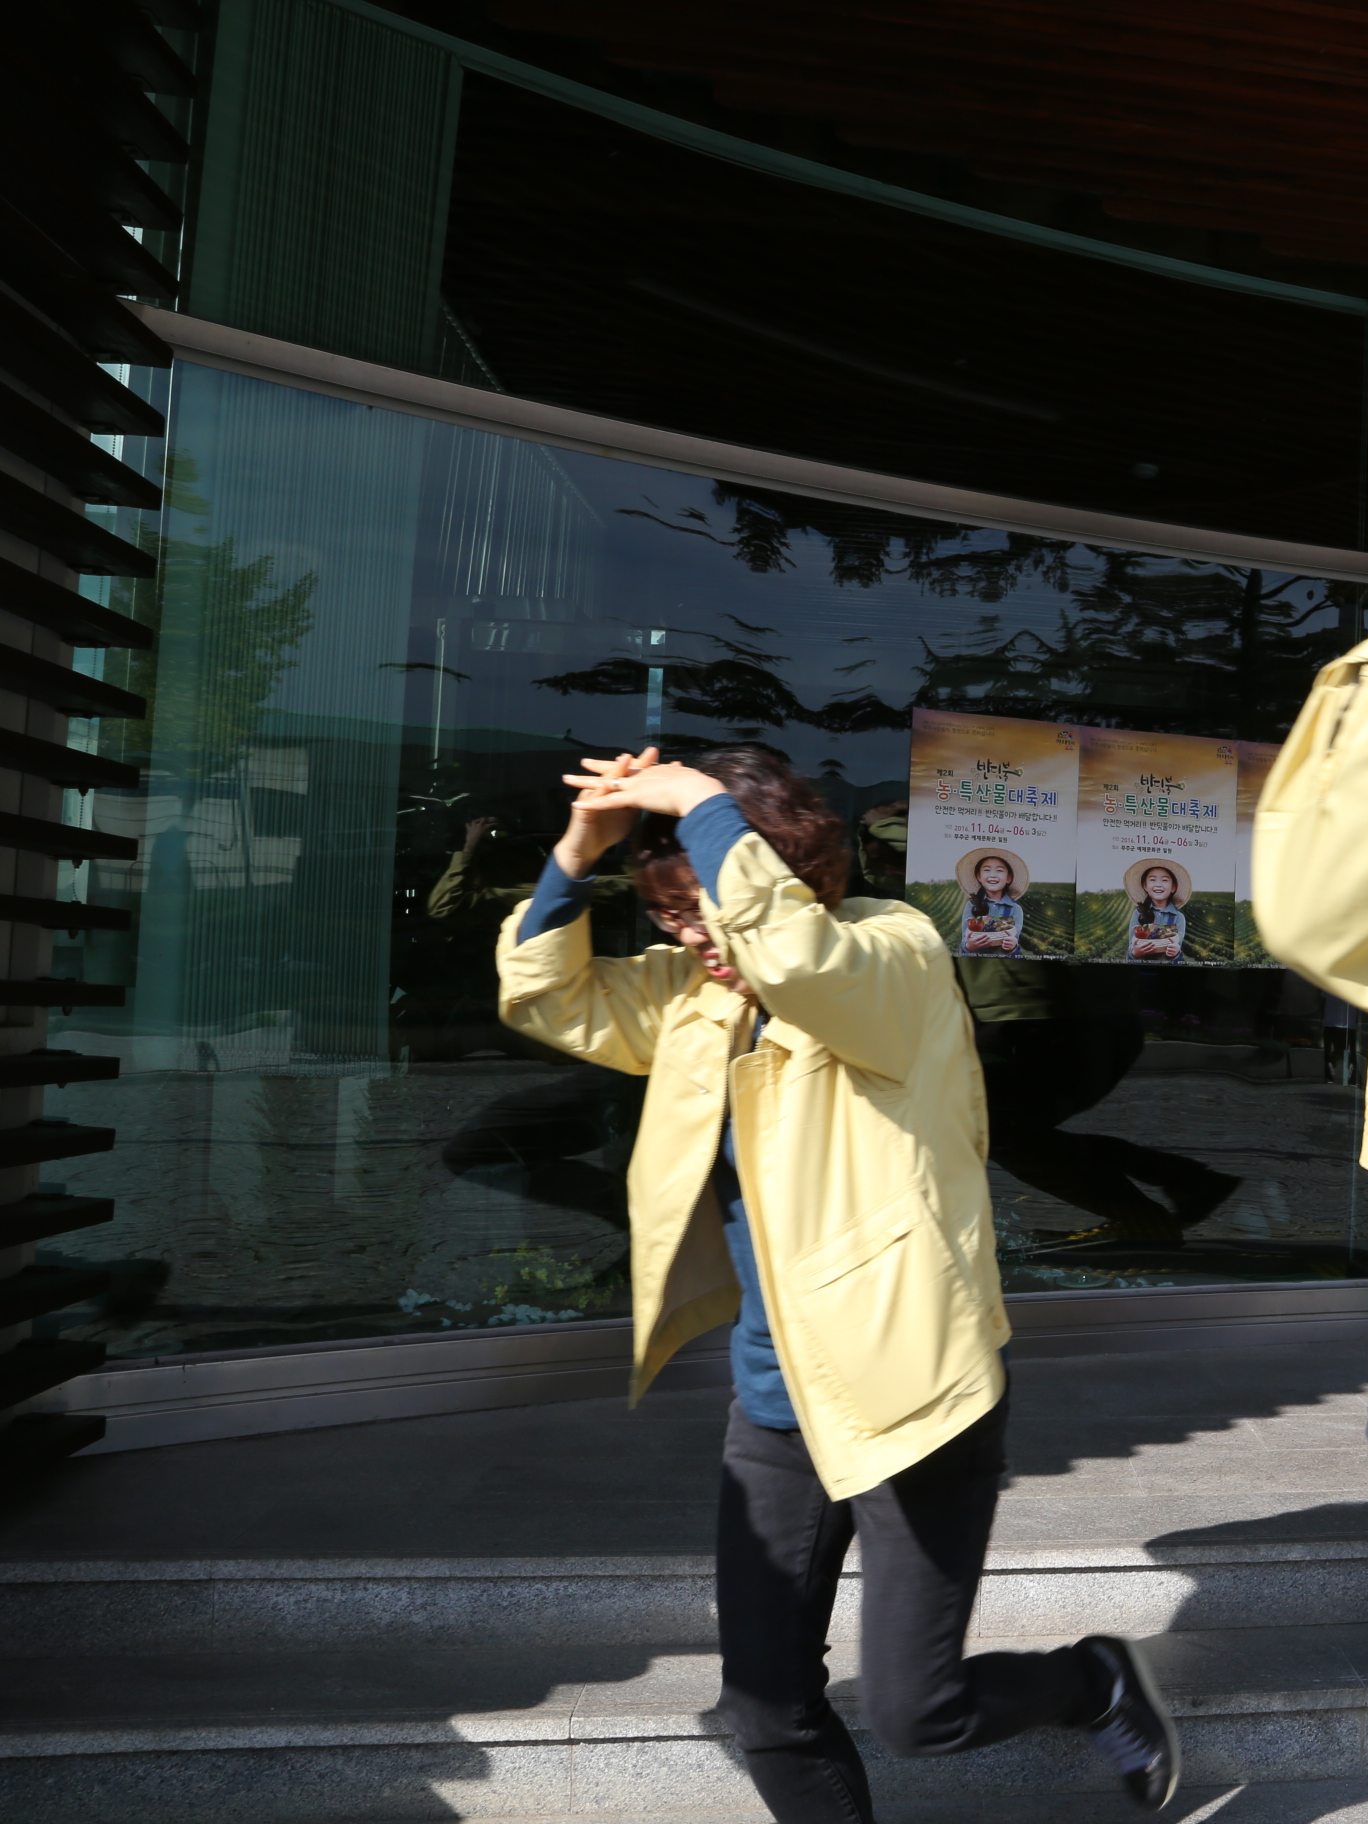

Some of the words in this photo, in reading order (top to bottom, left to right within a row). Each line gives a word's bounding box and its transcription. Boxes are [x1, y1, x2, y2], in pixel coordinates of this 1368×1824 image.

[937, 769, 954, 777] 제2회
[1103, 783, 1119, 792] 제2회
[935, 805, 956, 815] 안전한
[1102, 818, 1122, 828] 안전한
